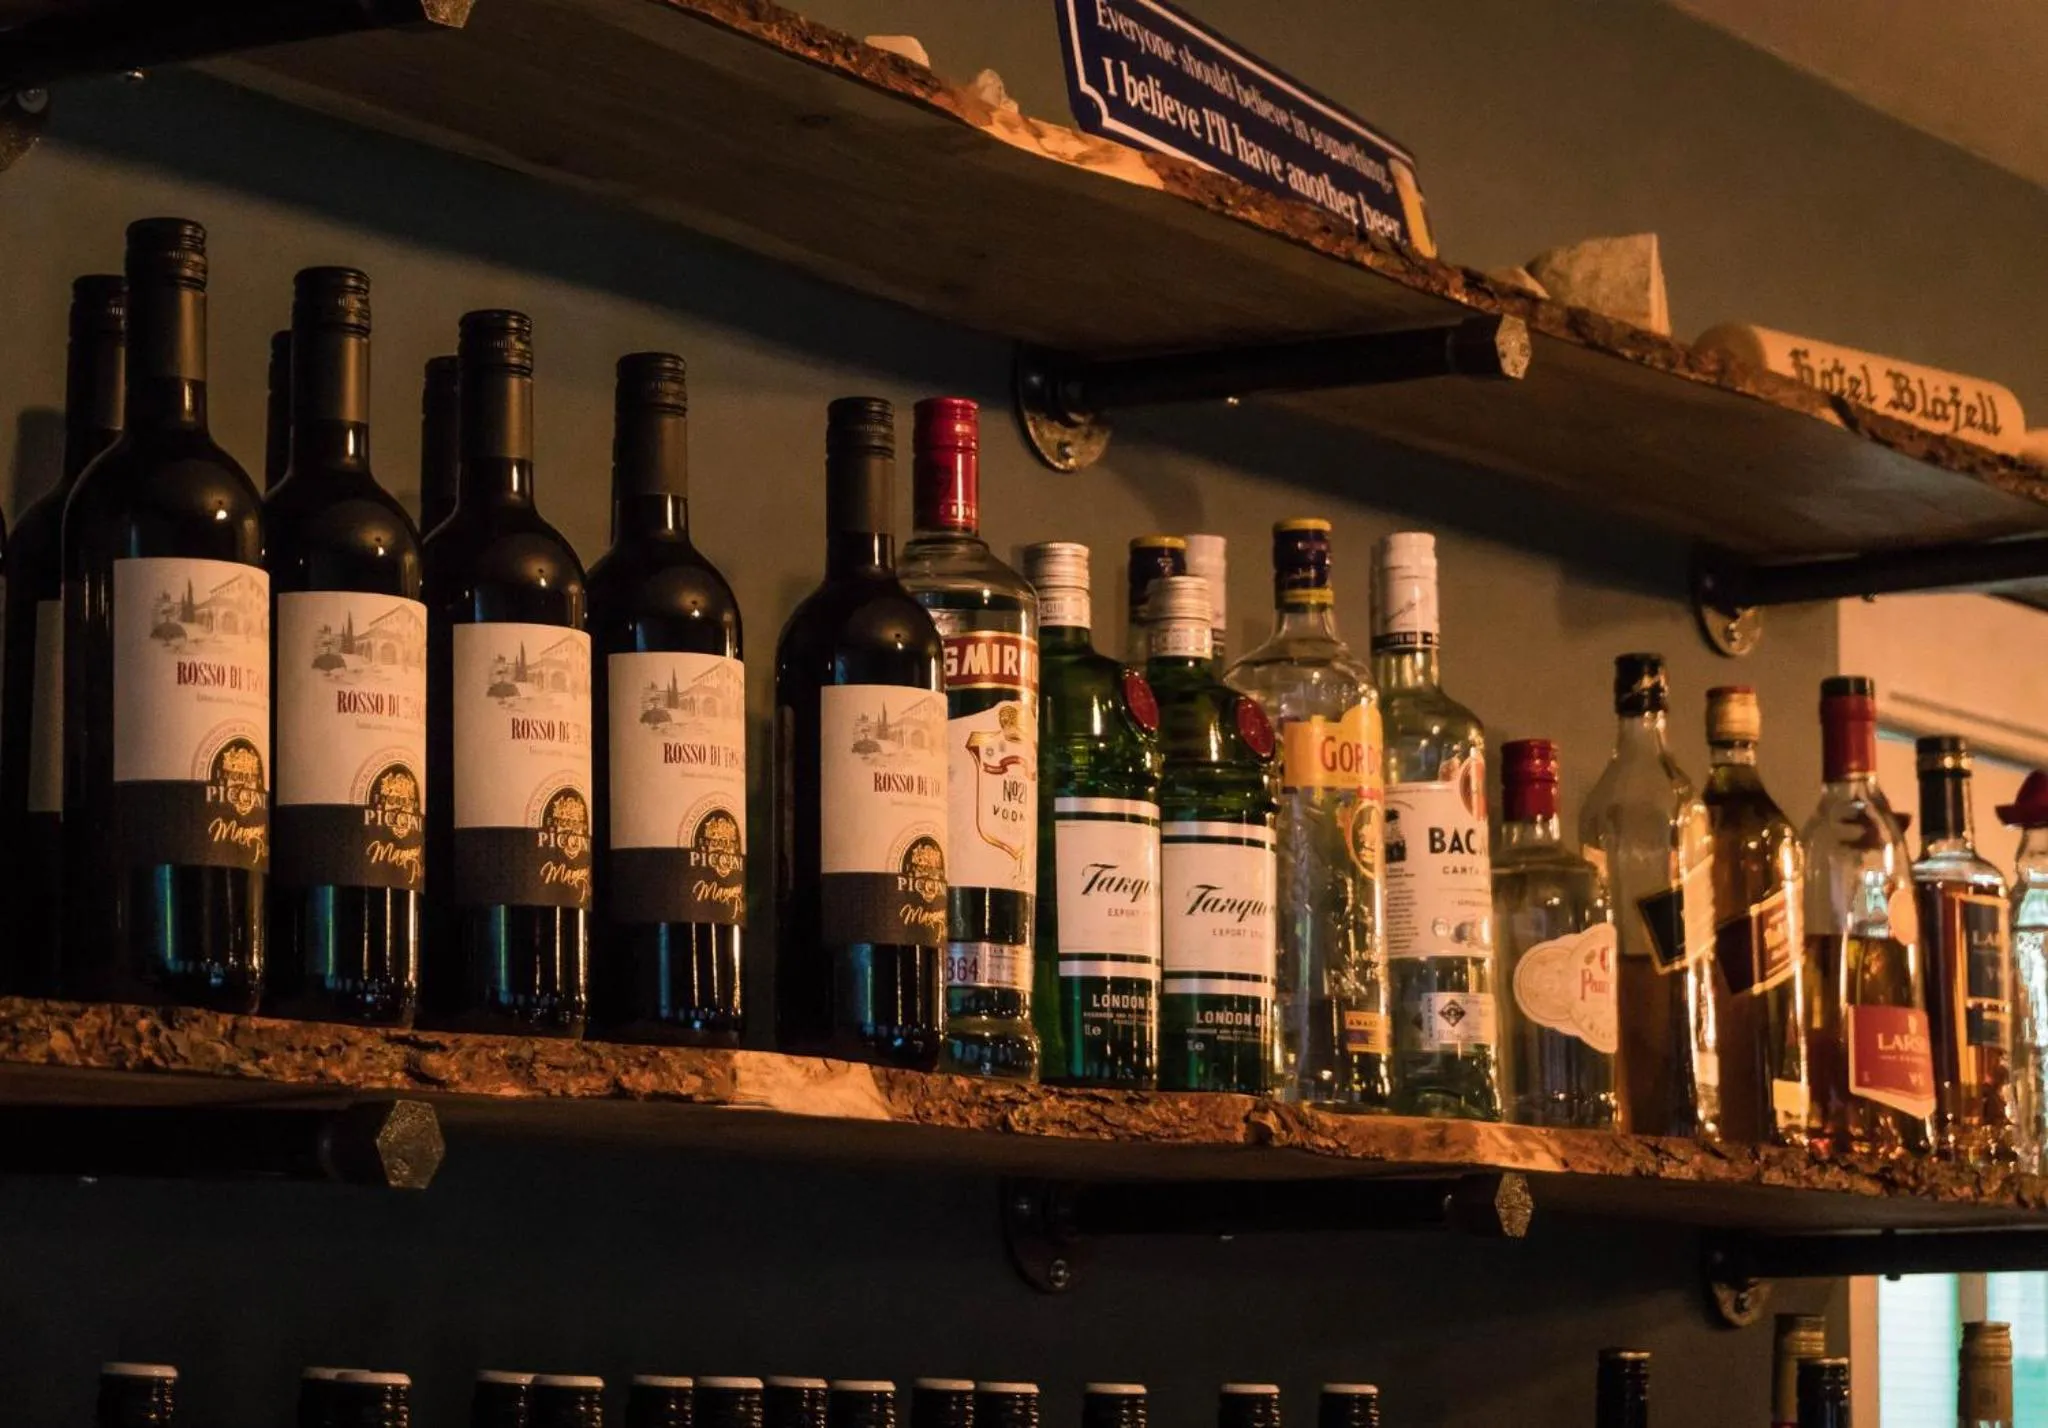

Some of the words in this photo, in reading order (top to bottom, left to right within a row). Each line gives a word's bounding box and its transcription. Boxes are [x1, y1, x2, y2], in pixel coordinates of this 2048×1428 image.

[1096, 0, 1177, 66] Everyone
[1178, 44, 1236, 100] should
[1232, 72, 1292, 134] believe
[1290, 109, 1311, 145] in
[1102, 56, 1119, 98] I
[1120, 60, 1202, 139] believe
[1202, 107, 1234, 156] I'll
[1231, 122, 1285, 184] have
[1286, 161, 1360, 225] another
[177, 661, 226, 686] ROSSO
[229, 666, 243, 690] DI
[336, 690, 385, 715] ROSSO
[388, 694, 401, 718] DI
[511, 717, 555, 742] ROSSO
[559, 720, 570, 743] DI
[663, 742, 707, 765] ROSSO
[710, 744, 721, 768] DI
[873, 771, 915, 793] ROSSO
[1092, 993, 1145, 1009] LONDON
[1196, 1010, 1252, 1027] LONDON
